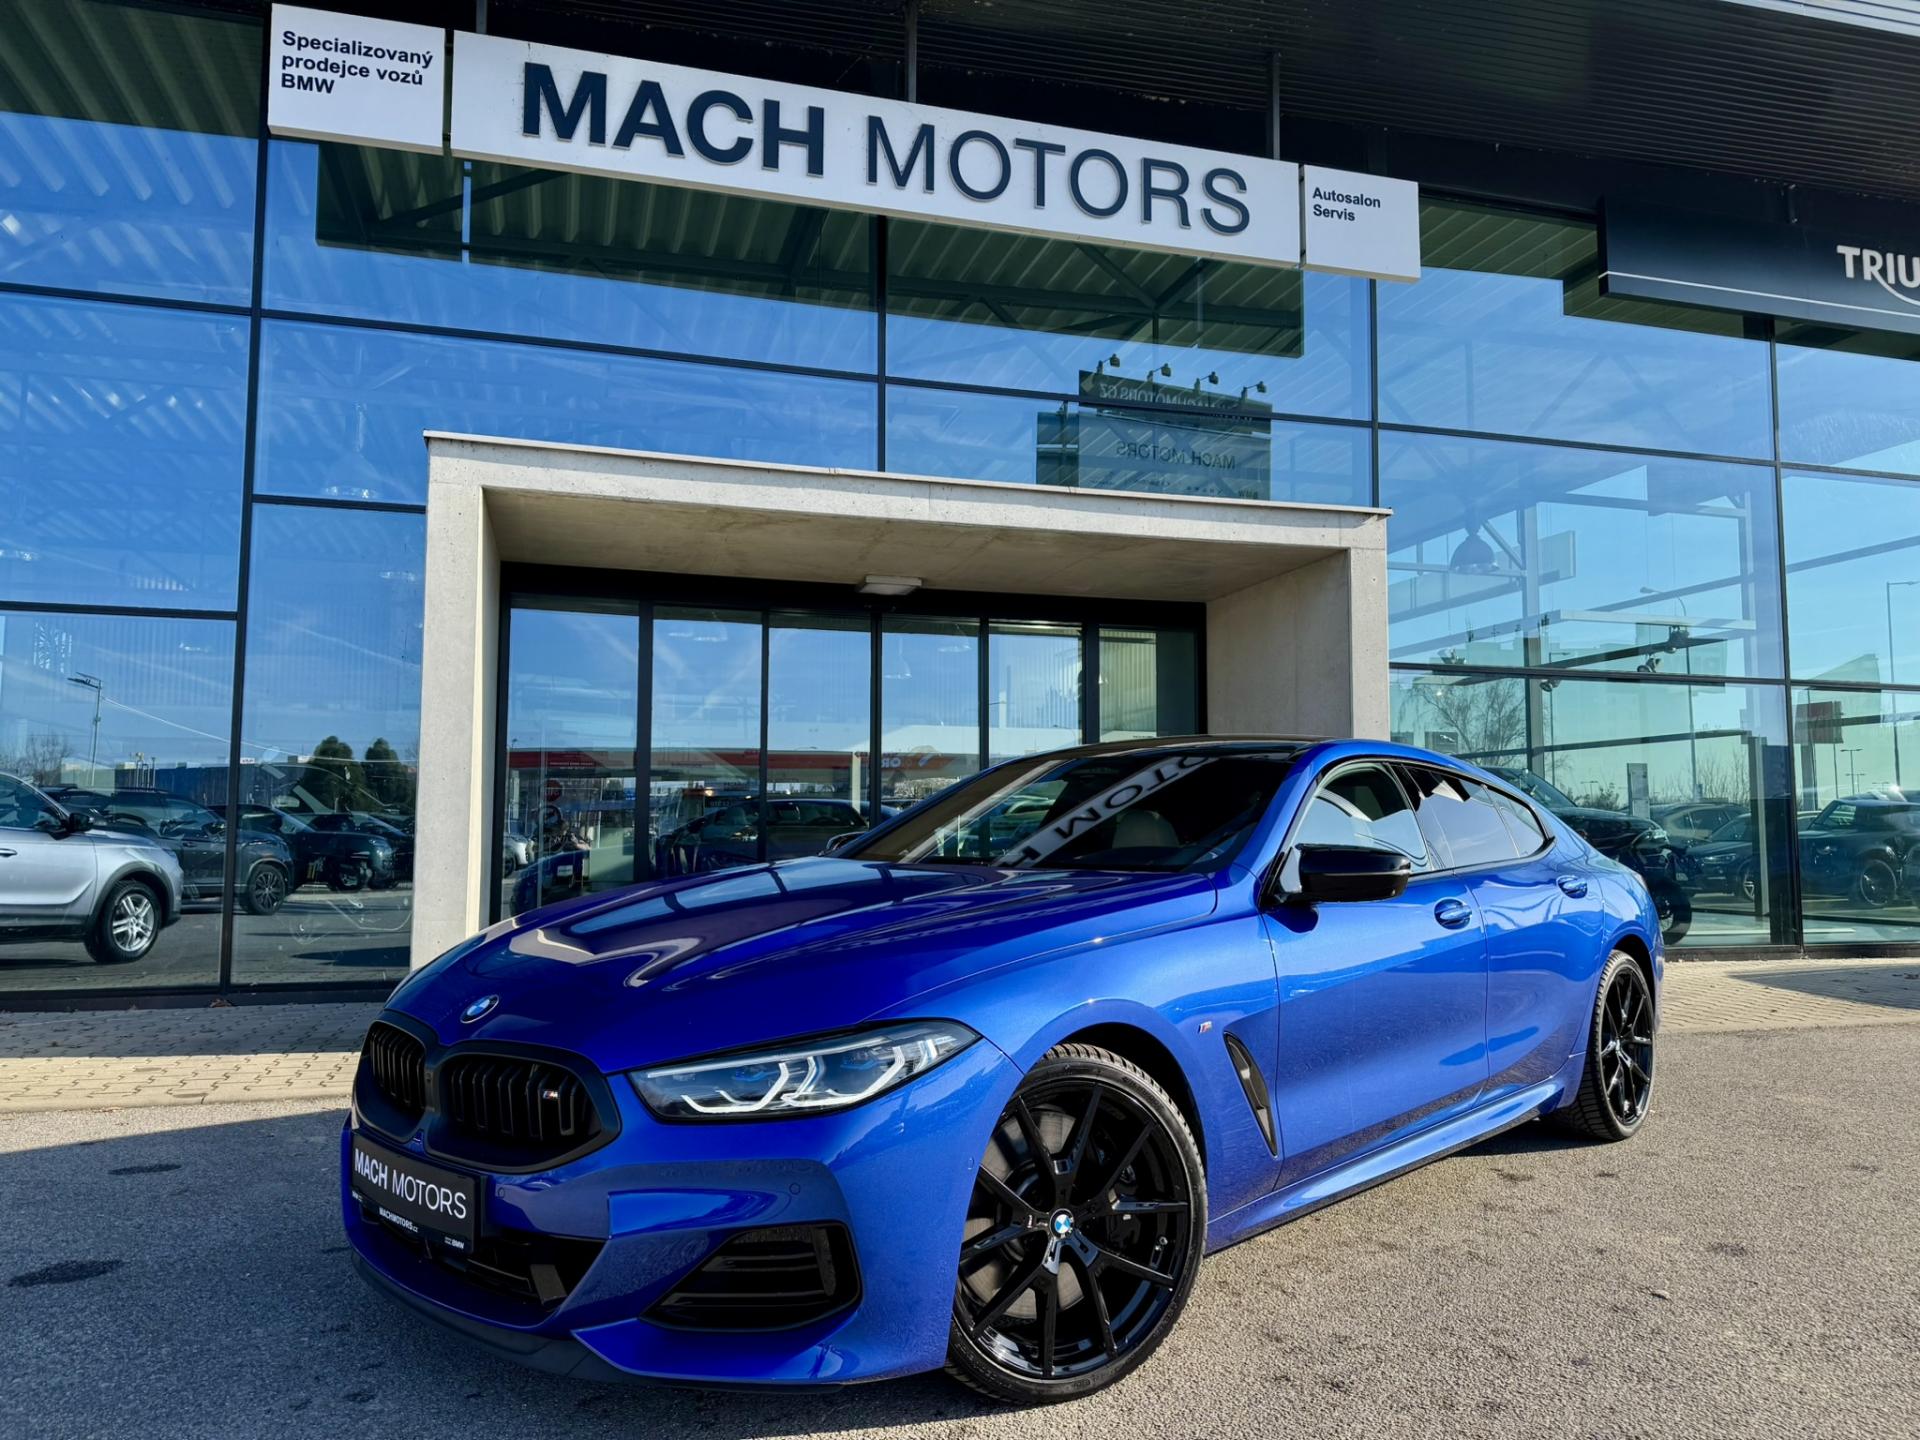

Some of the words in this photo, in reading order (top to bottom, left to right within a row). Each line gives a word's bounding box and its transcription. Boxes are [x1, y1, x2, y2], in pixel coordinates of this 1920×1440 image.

[282, 30, 433, 69] Specializovaný
[280, 73, 336, 94] BMW
[281, 54, 370, 78] prodejce
[376, 66, 424, 86] vozů
[522, 61, 825, 178] MACH
[865, 115, 1251, 235] MOTORS
[1312, 187, 1381, 208] Autosalon
[1313, 204, 1356, 222] Servis
[354, 1147, 388, 1190] MACH
[391, 1169, 467, 1219] MOTORS
